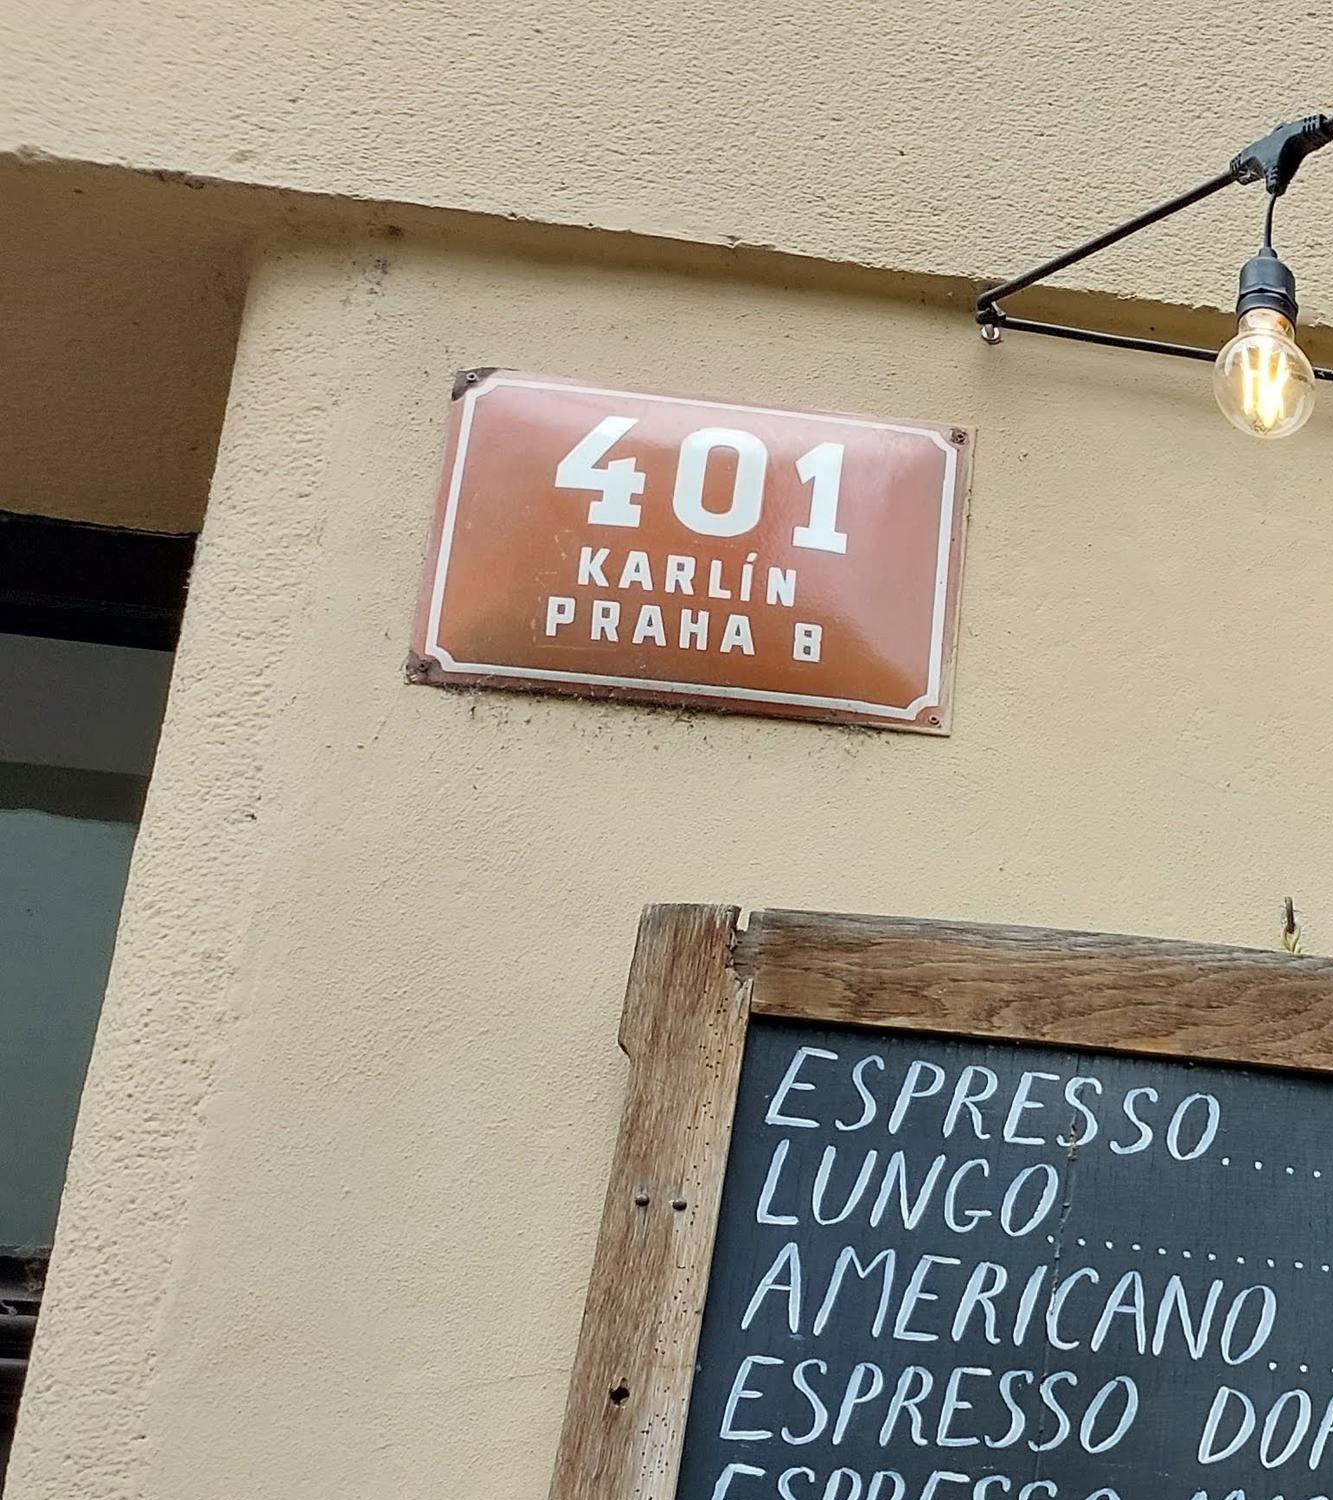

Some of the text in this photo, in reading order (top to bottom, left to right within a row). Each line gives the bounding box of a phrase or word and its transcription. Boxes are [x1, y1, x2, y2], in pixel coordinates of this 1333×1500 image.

[555, 416, 848, 554] 401
[577, 546, 796, 607] KARLÍN
[545, 596, 824, 663] PRAHA 8
[765, 1047, 1221, 1161] ESPRESSO
[757, 1139, 1058, 1236] LUNGO
[742, 1242, 1277, 1365] AMERICANO
[719, 1356, 1139, 1453] ESPRESSO
